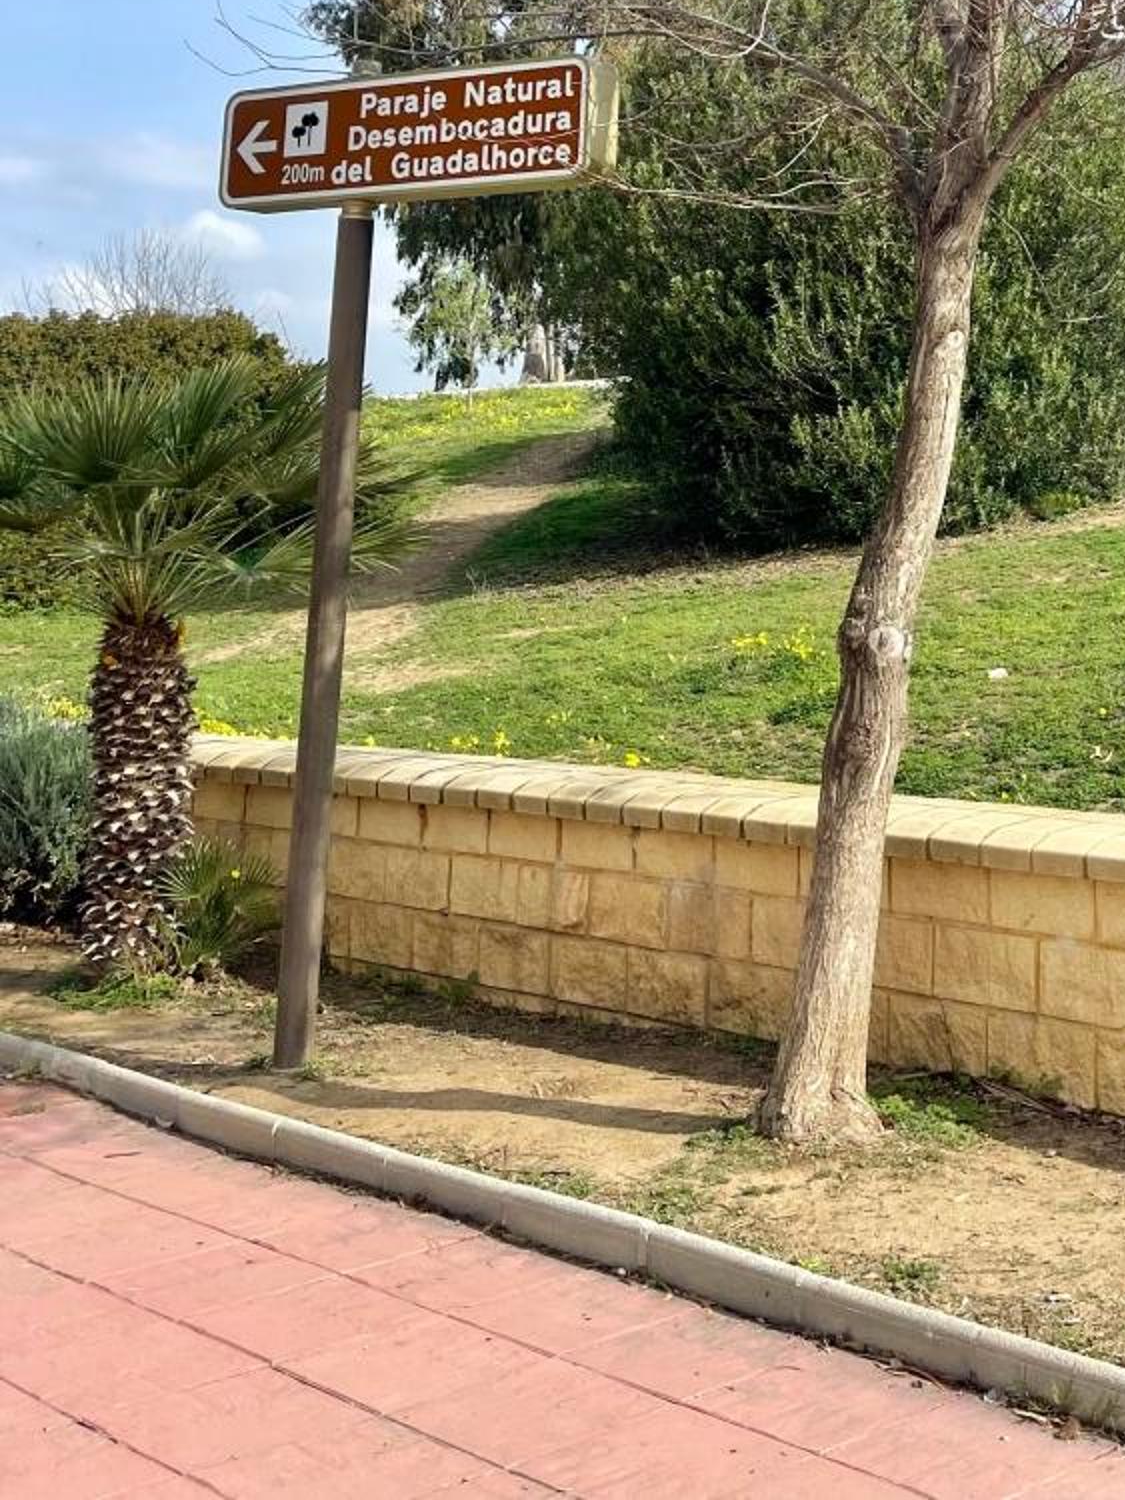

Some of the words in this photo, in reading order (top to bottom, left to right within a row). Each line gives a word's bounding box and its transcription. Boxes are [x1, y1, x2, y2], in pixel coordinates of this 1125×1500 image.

[360, 87, 447, 120] Paraje
[464, 71, 575, 108] Natural
[347, 110, 572, 151] Desembocadura
[280, 164, 325, 186] 200m
[331, 157, 373, 185] del
[390, 143, 571, 181] Guadalhorce
